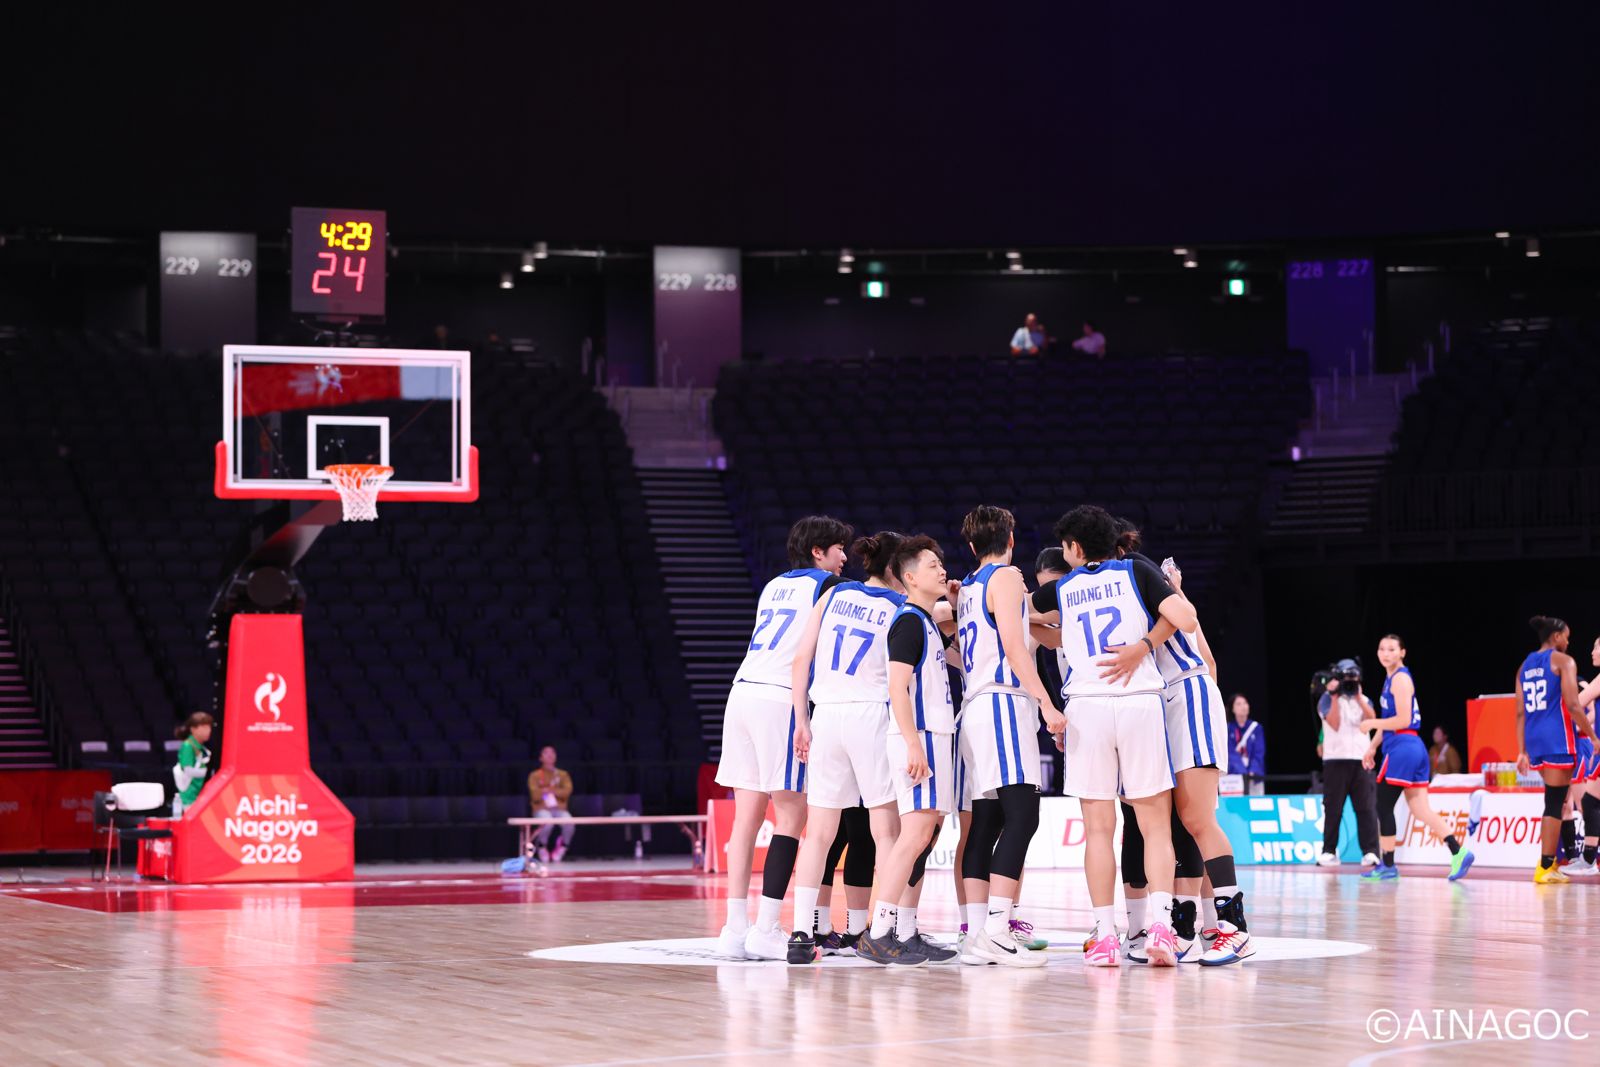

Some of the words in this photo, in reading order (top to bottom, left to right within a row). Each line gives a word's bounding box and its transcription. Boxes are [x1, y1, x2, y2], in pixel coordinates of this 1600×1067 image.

[320, 222, 373, 251] 4:29
[165, 257, 200, 275] 229
[217, 259, 252, 277] 229
[312, 252, 367, 294] 24
[1337, 258, 1369, 277] 227
[659, 273, 692, 291] 229
[703, 273, 738, 291] 228
[771, 588, 789, 602] LIN
[1066, 586, 1102, 608] HUANG
[1105, 581, 1126, 599] H.T.
[831, 599, 865, 620] HUANG
[867, 608, 887, 628] L.C.
[750, 608, 798, 651] 27
[1077, 605, 1127, 658] 12
[831, 624, 876, 676] 17
[1523, 679, 1547, 713] 32
[236, 794, 308, 816] Aichi-
[225, 817, 318, 842] Nagoya
[1477, 816, 1543, 844] TOYOT
[240, 844, 302, 864] 2026
